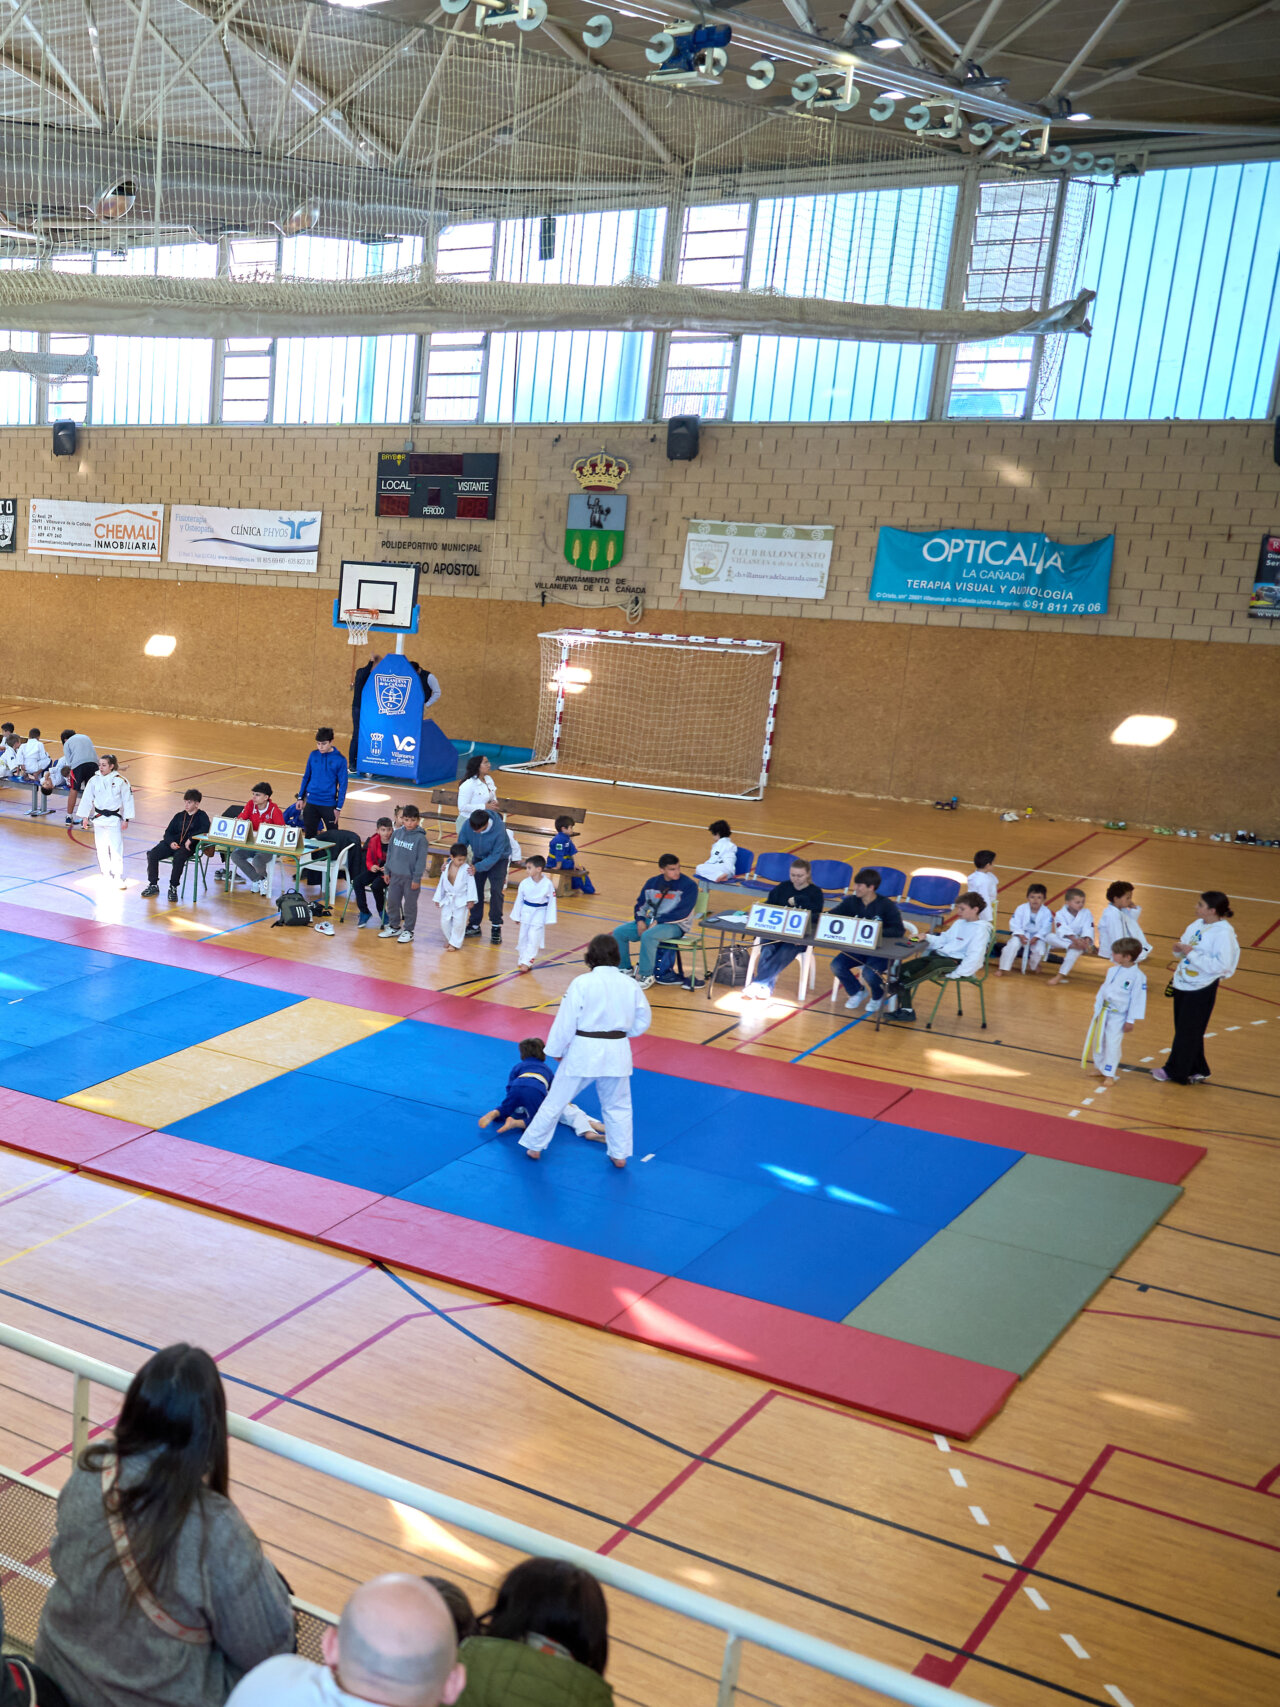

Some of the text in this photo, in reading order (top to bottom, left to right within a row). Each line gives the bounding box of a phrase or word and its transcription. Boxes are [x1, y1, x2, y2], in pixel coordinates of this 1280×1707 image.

[382, 480, 489, 491] LOCAL VISITANTE
[175, 513, 207, 524] Fisioterapia
[94, 523, 156, 540] CHEMALI
[230, 524, 289, 537] CLÍNICA PHYOS
[94, 540, 157, 550] INMOBILIARIA
[381, 540, 482, 552] POLIDEPORTIVO MUNICIPAL
[732, 548, 826, 560] CLUB BALONCESTO
[922, 538, 1065, 574] OPTICALIA
[433, 563, 480, 576] APOSTOL
[963, 569, 1025, 581] LA CAÑADA
[555, 575, 610, 584] AYUNTAMIENTO
[534, 582, 578, 590] VILLANUEVA
[615, 585, 646, 594] CAÑADA
[906, 579, 1073, 600] TERAPIA VISUAL Y AUDIOLOGÍA
[1031, 600, 1101, 612] 91 811 76 06
[392, 734, 416, 752] VC
[218, 820, 245, 836] 0 0
[265, 828, 296, 842] 0 0
[790, 914, 802, 928] 0
[829, 920, 873, 939] 0 0
